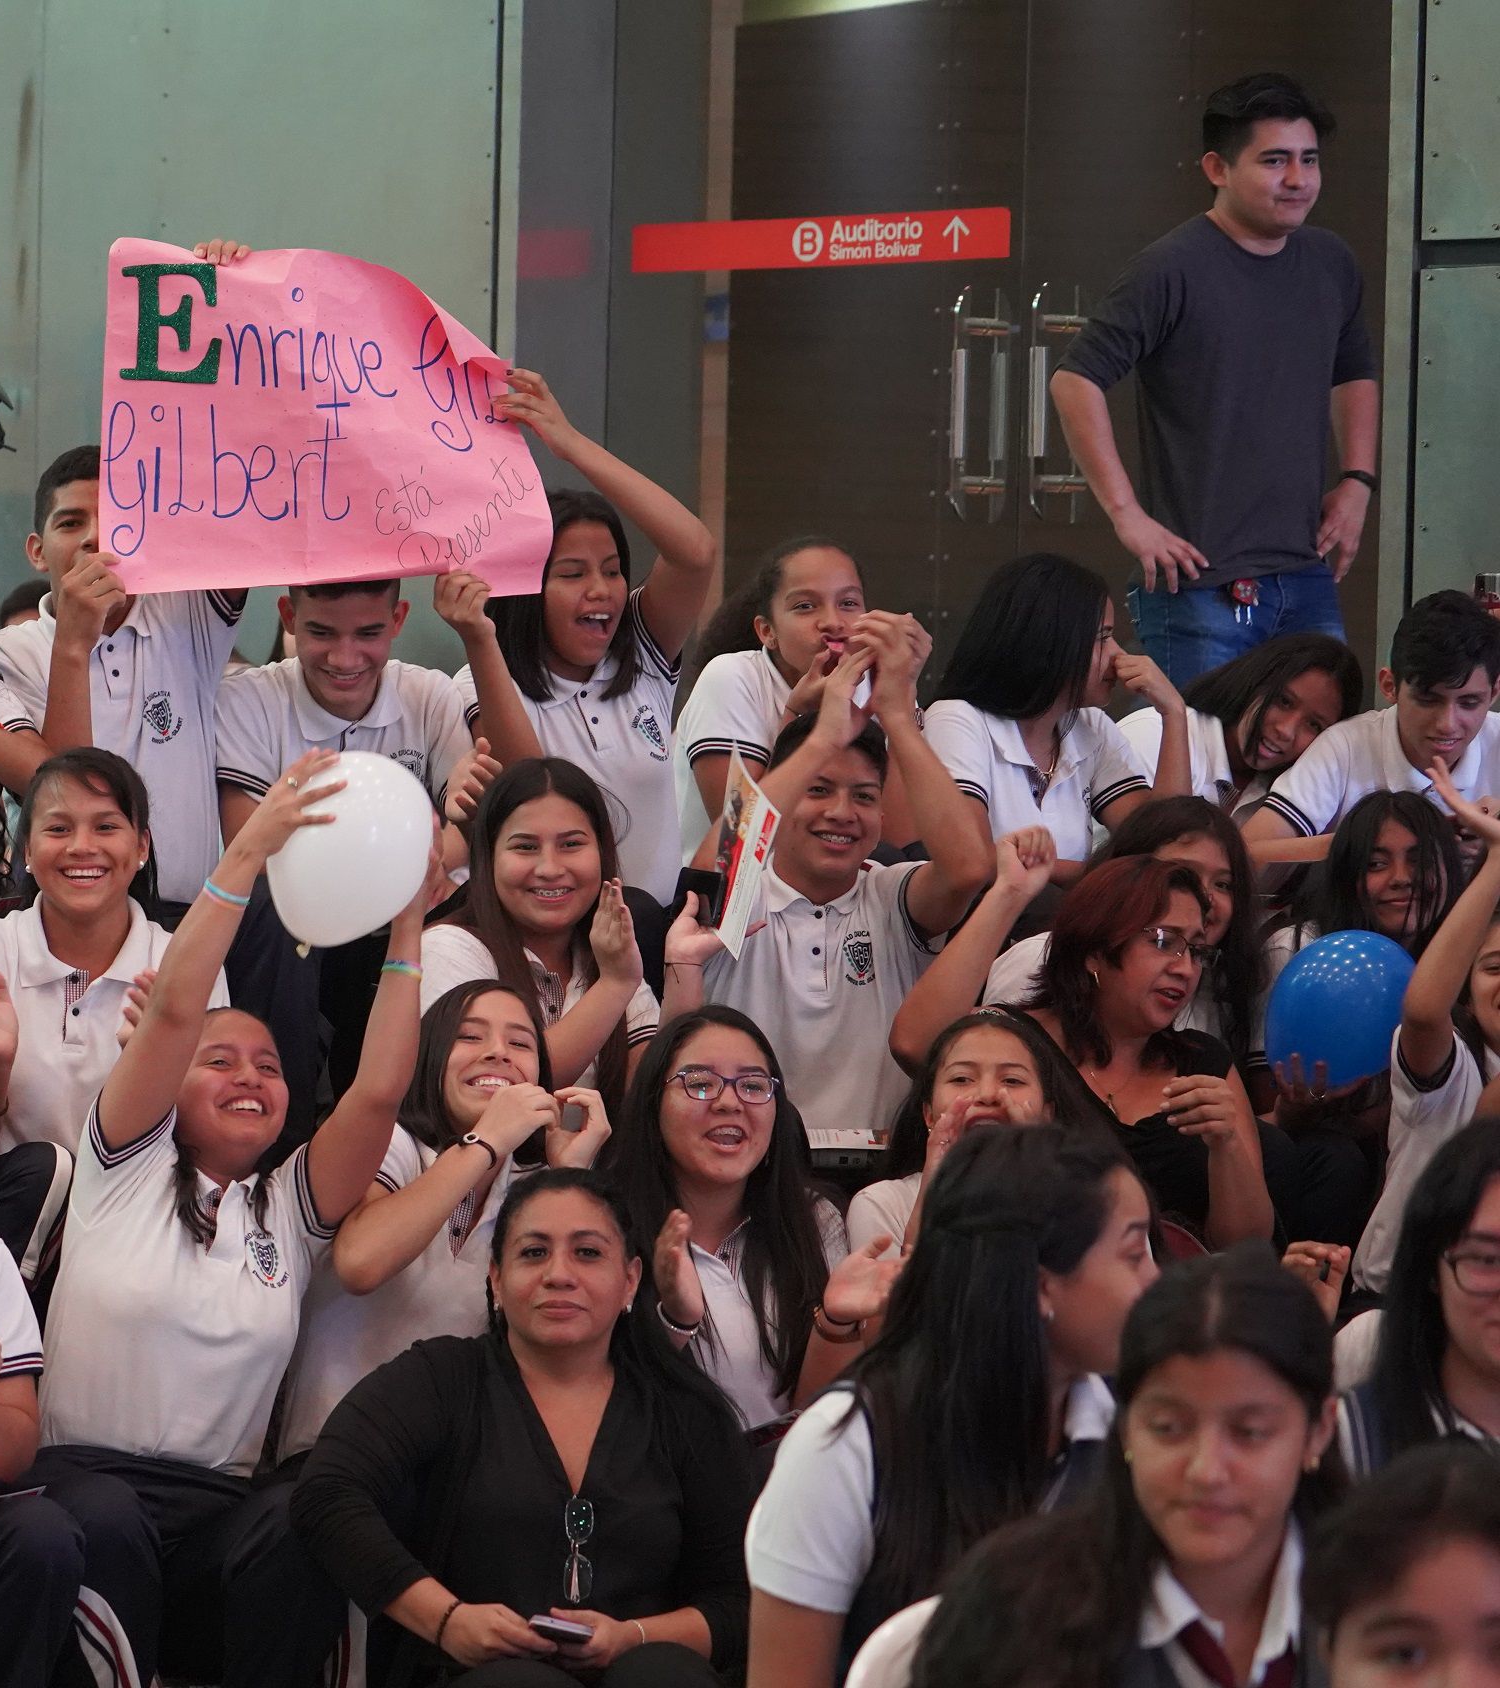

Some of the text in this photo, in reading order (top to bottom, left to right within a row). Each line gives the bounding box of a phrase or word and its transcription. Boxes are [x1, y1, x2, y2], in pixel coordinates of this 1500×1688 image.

[830, 216, 923, 243] Auditorio
[120, 263, 397, 436] Enrique
[376, 465, 443, 535] Está
